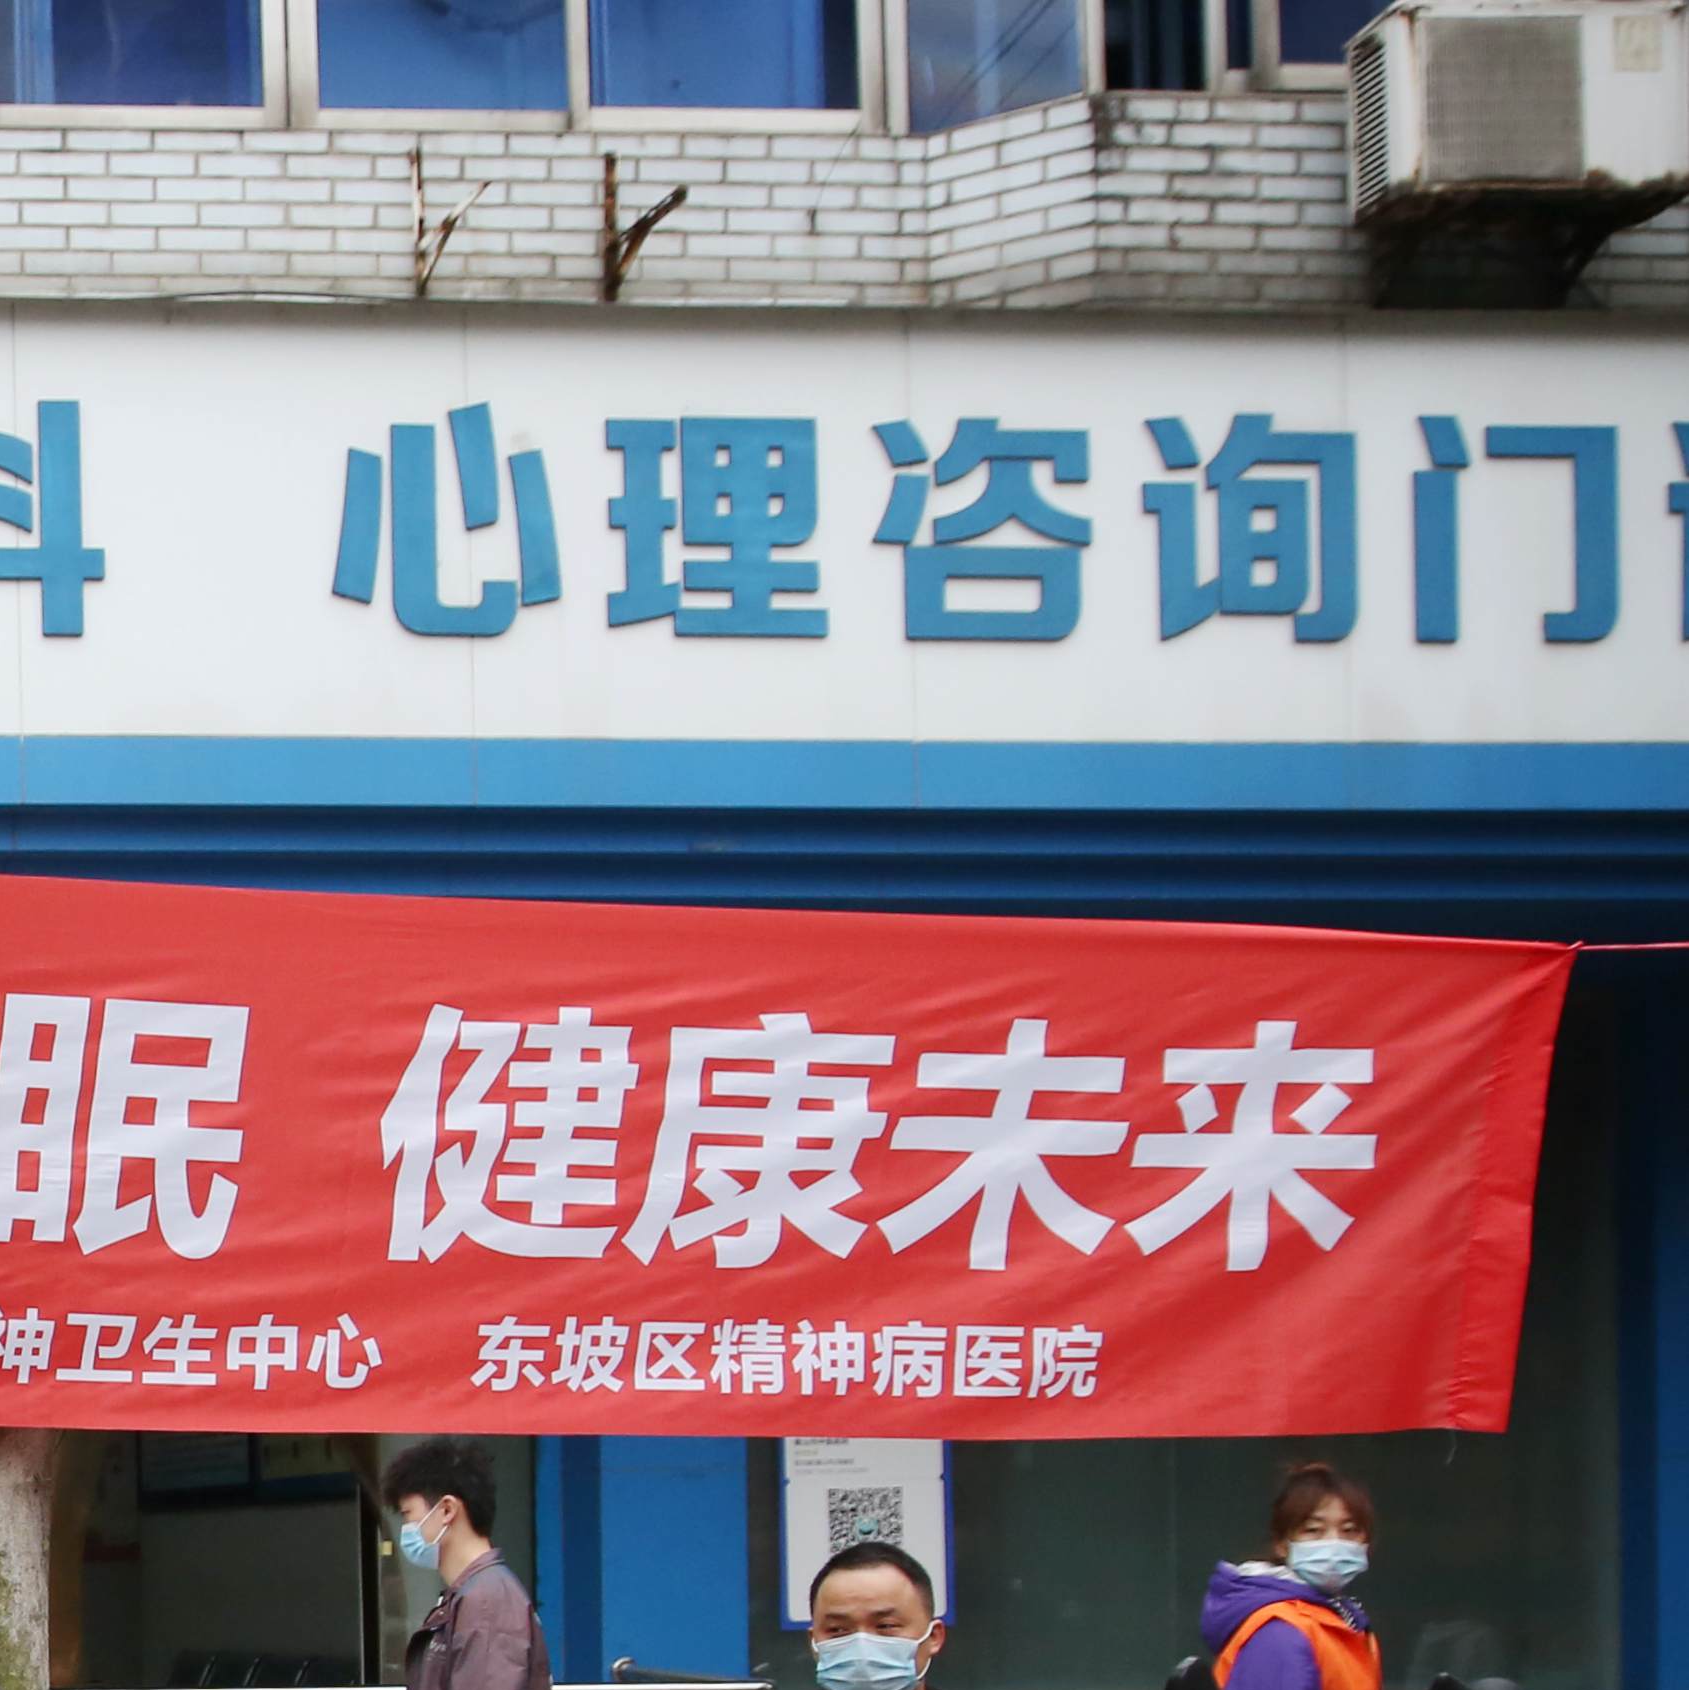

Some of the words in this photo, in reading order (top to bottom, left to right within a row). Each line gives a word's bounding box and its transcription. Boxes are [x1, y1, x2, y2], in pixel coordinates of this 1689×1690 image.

[332, 402, 1689, 643] 心理咨询门
[379, 1003, 1378, 1273] 健康未来
[469, 1315, 1104, 1399] 东坡区精神病医院
